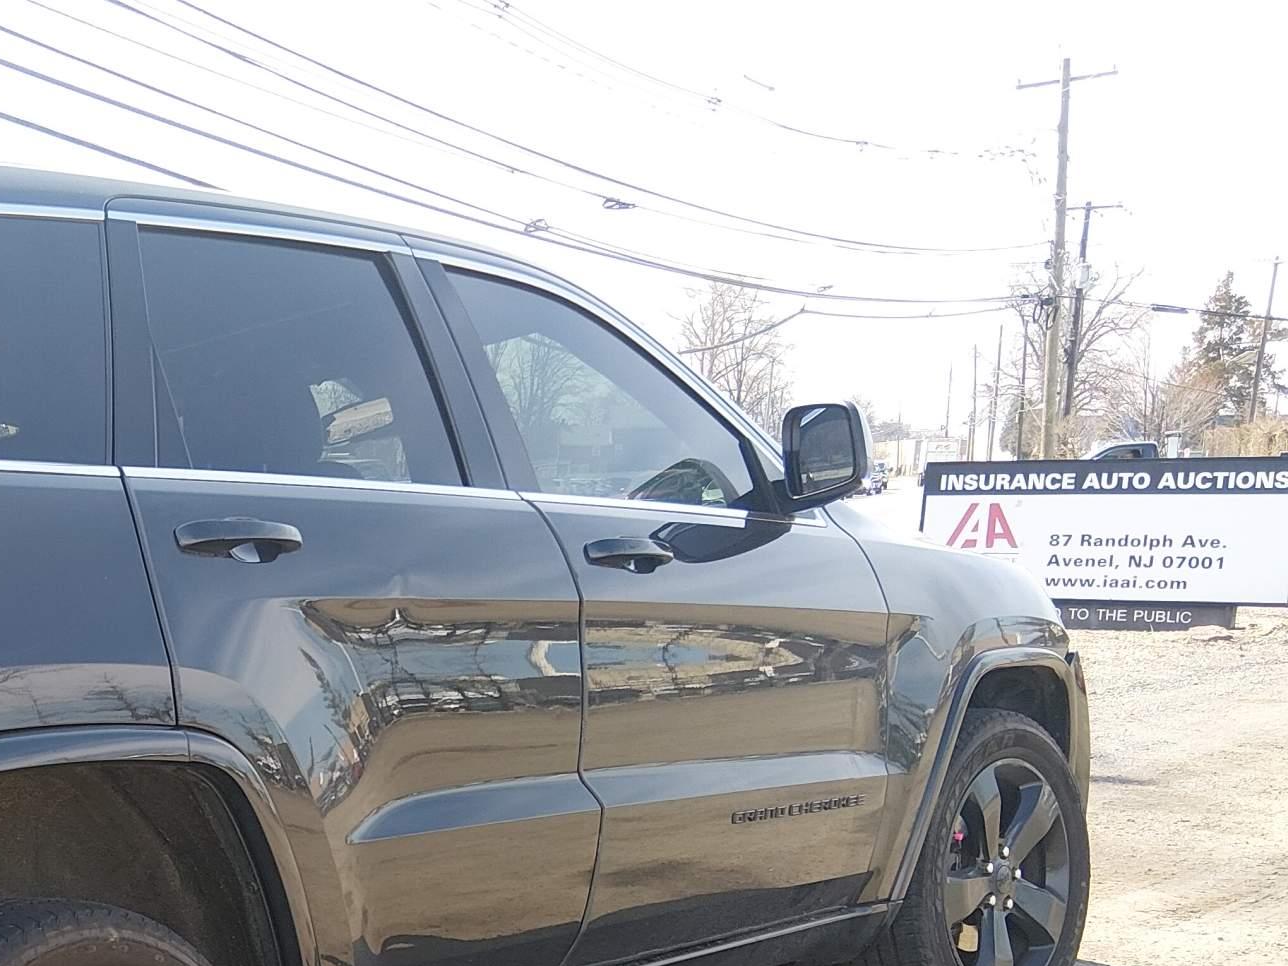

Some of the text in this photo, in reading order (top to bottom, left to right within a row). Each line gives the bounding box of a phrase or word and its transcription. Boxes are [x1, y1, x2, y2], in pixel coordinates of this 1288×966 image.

[939, 471, 1288, 491] INSURANCE AUTO AUCTIONS
[1049, 533, 1228, 551] 87 Randolph Ave.
[1046, 553, 1225, 570] Avenel, NJ 07001
[1044, 575, 1188, 590] www.iaai.com
[1068, 607, 1090, 621] TO
[1096, 608, 1128, 622] THE
[1132, 610, 1193, 624] PUBLIC
[731, 794, 867, 825] GRAND CHEROKEE
